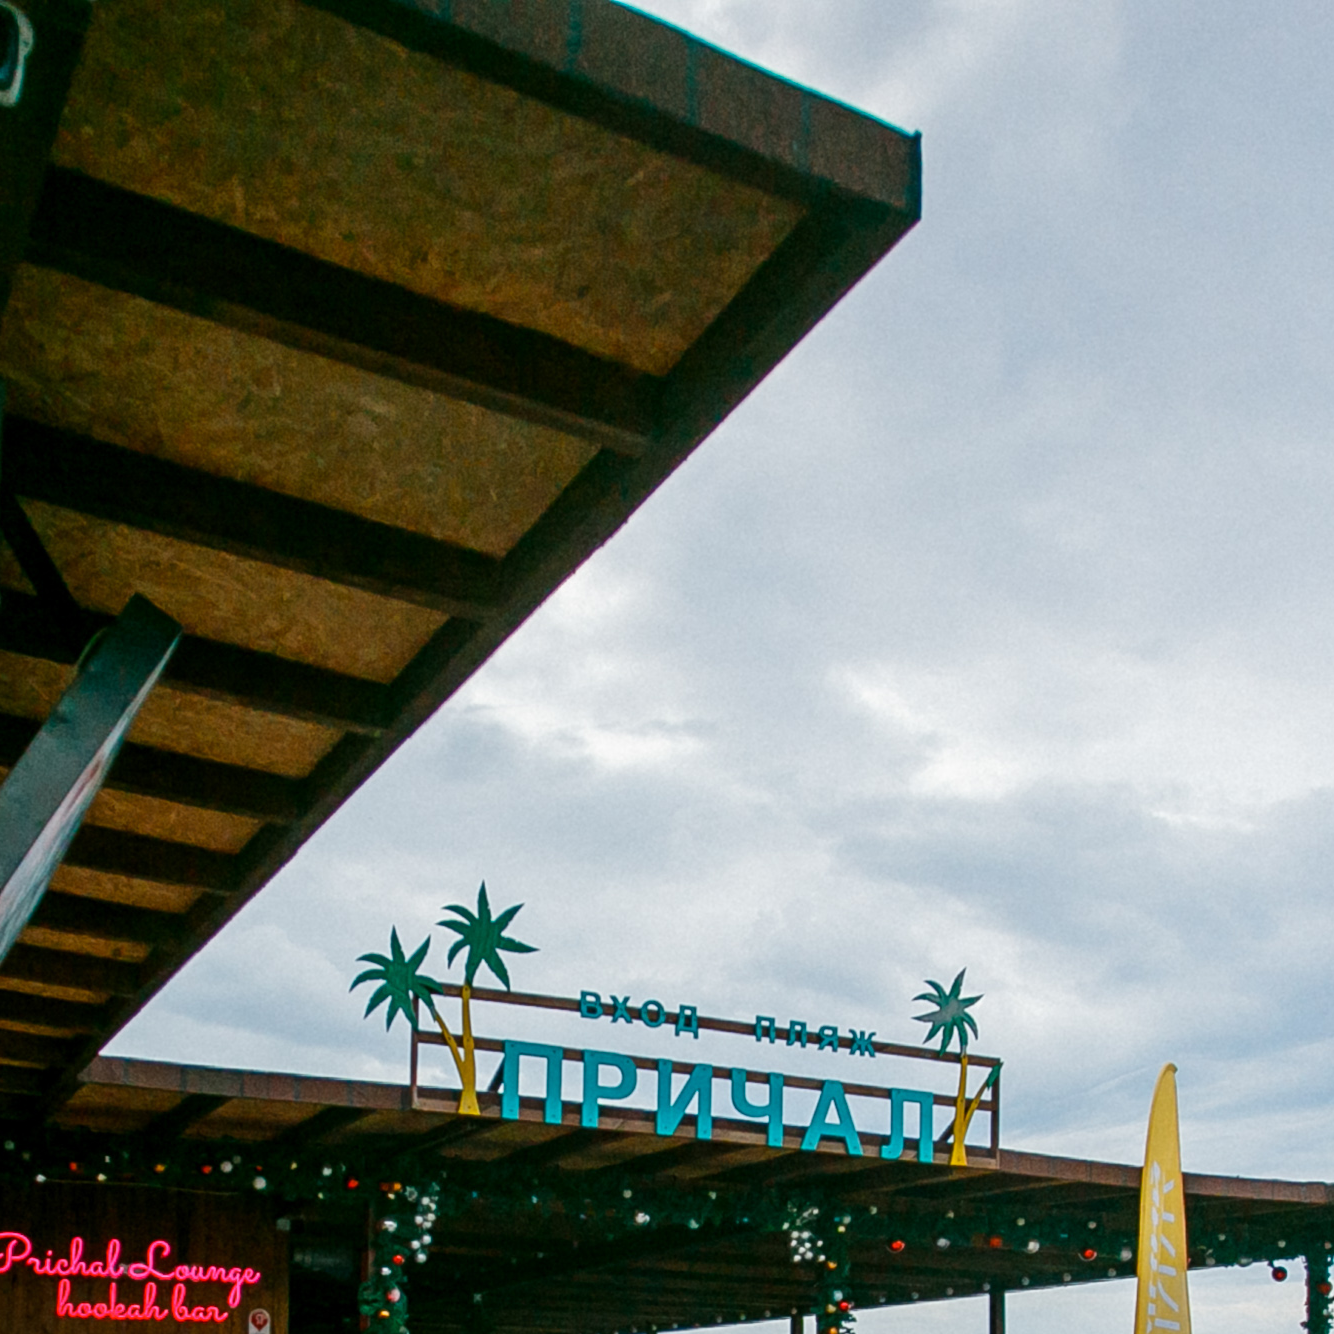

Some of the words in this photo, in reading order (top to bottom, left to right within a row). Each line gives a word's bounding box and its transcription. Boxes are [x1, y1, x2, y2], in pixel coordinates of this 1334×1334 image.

[579, 989, 699, 1040] ВХОД
[754, 1014, 878, 1058] ПЛЯЖ
[501, 1039, 935, 1164] ПРИЧАЛ
[56, 1279, 168, 1322] hookah
[171, 1283, 229, 1323] bar
[127, 1240, 262, 1309] Lounge
